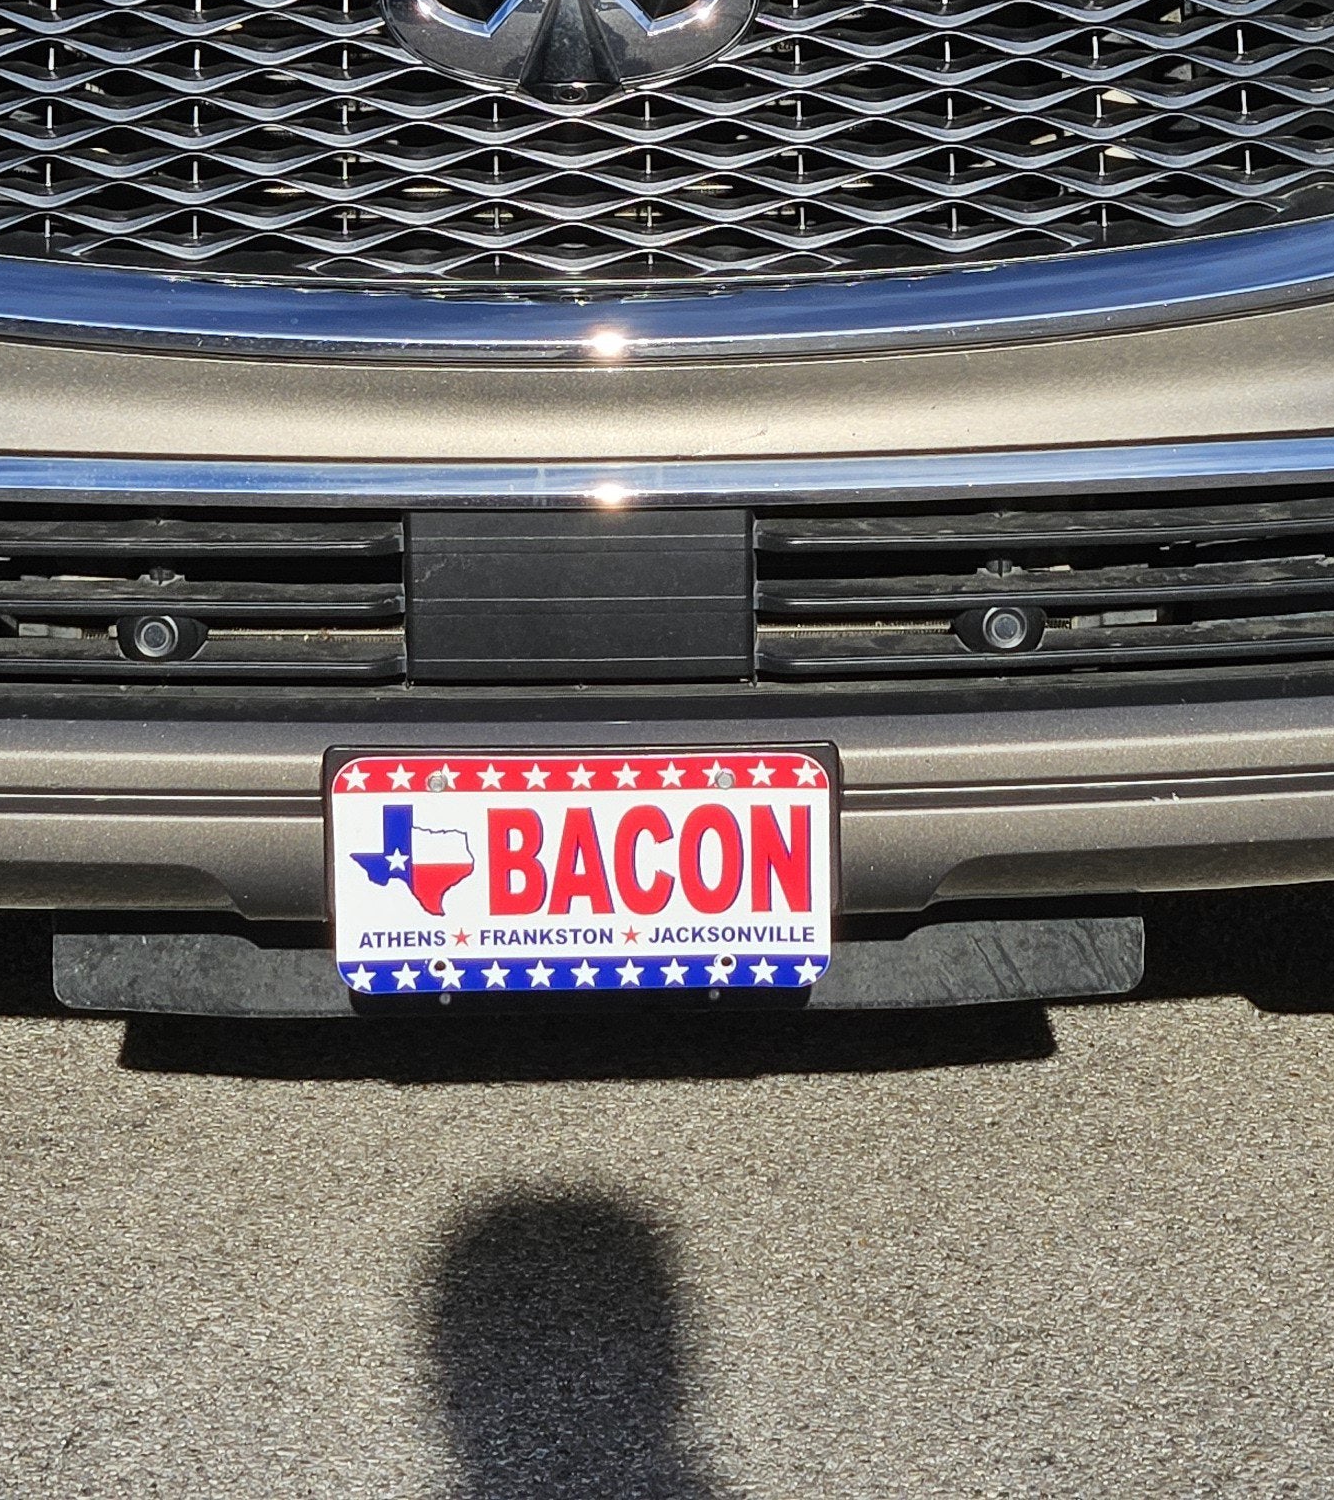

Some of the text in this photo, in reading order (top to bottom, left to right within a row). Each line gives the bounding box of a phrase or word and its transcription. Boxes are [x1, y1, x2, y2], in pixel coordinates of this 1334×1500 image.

[487, 803, 812, 916] BACON
[359, 925, 815, 949] ATHENS FRANKSTON JACKSONVILLE
